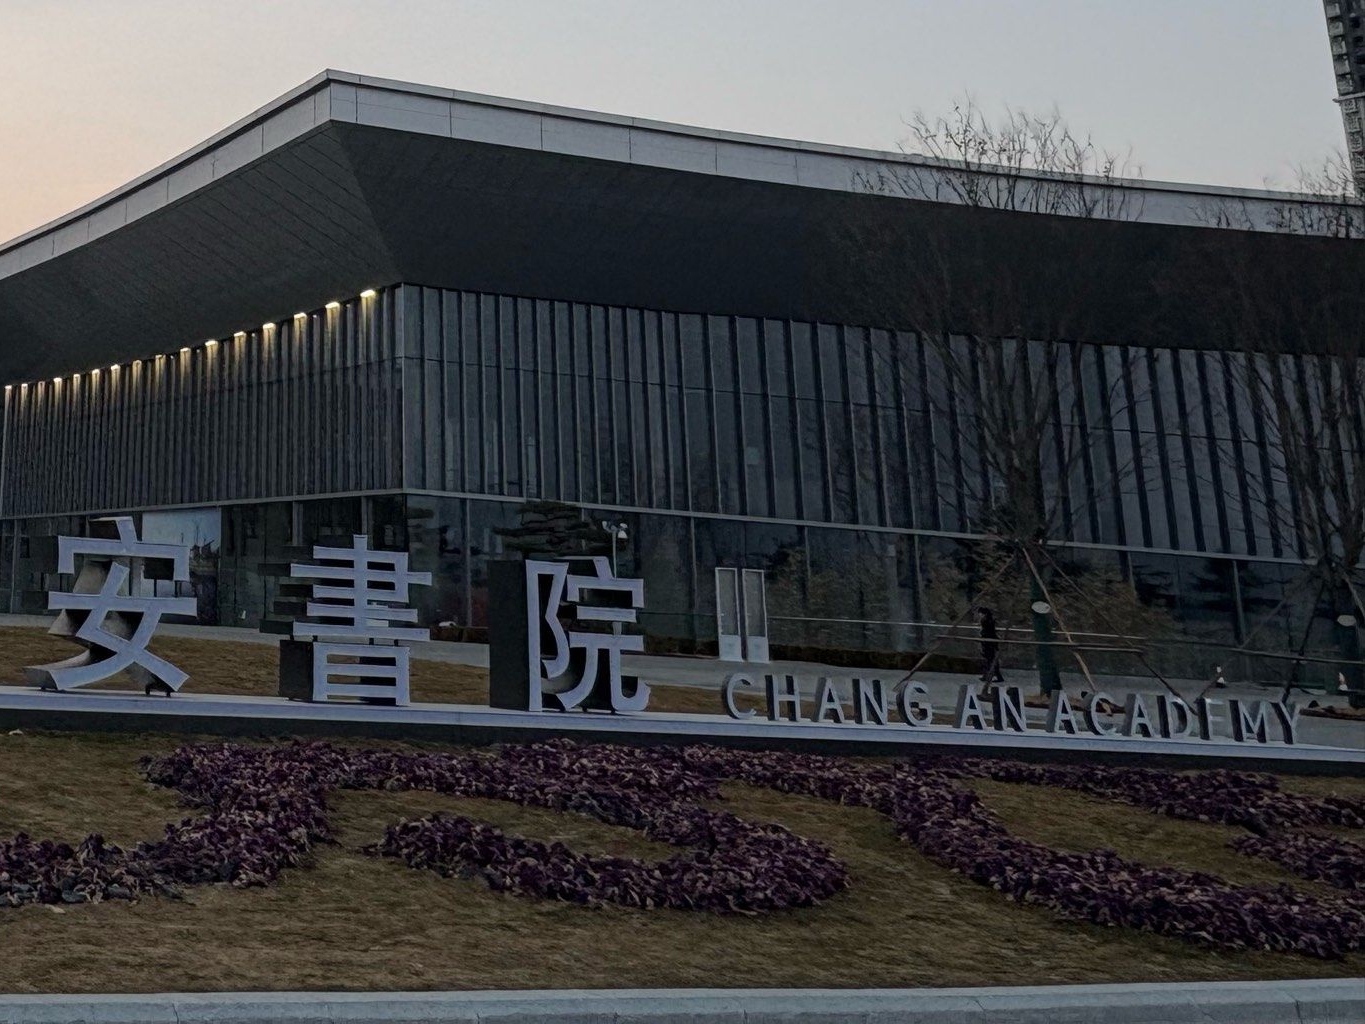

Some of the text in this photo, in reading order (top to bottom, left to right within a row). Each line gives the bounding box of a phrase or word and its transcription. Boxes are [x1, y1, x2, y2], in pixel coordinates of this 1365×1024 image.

[723, 673, 1301, 745] CHANG AN ACADEMY
